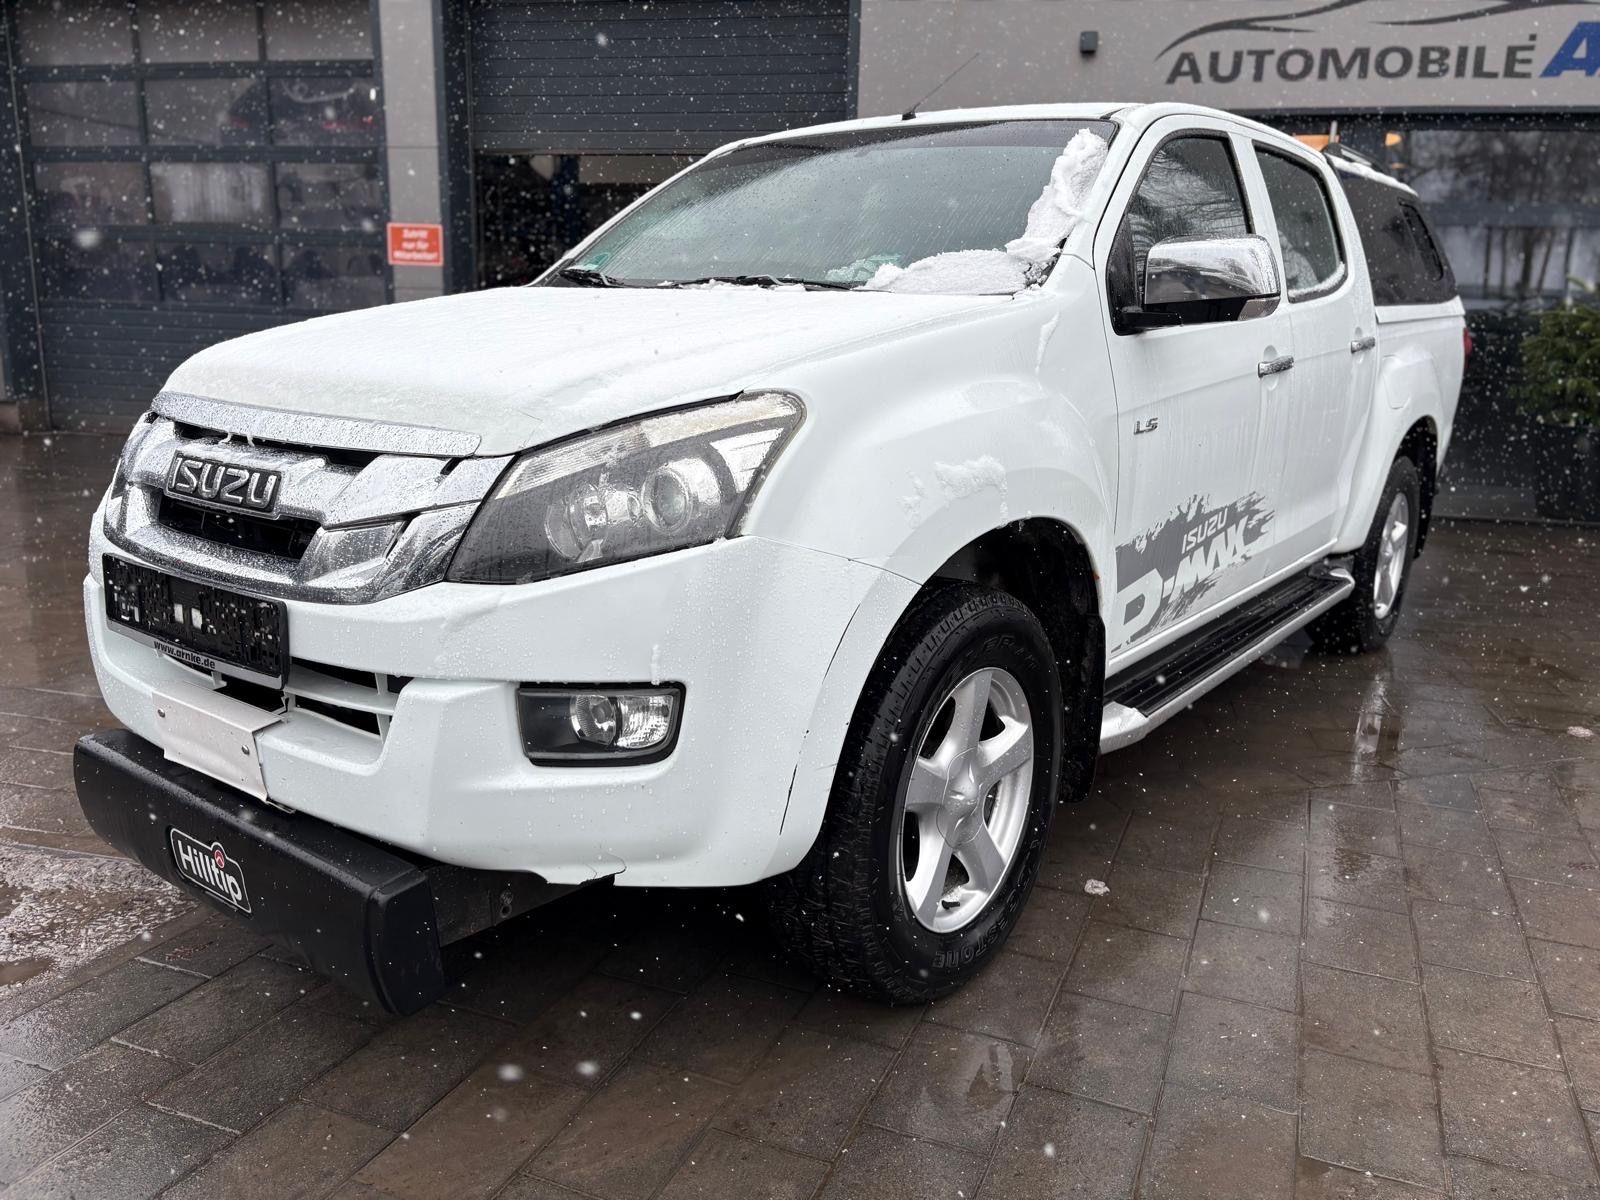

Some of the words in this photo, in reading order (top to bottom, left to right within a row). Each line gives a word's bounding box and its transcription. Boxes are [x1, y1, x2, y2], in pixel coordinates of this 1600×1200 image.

[1165, 45, 1536, 84] AUTOMOBILE
[1133, 416, 1158, 435] LS
[168, 457, 278, 509] ISUZU
[1181, 507, 1229, 554] ISUZU
[153, 640, 216, 669] www.arnke.de
[177, 839, 243, 905] Hilltip
